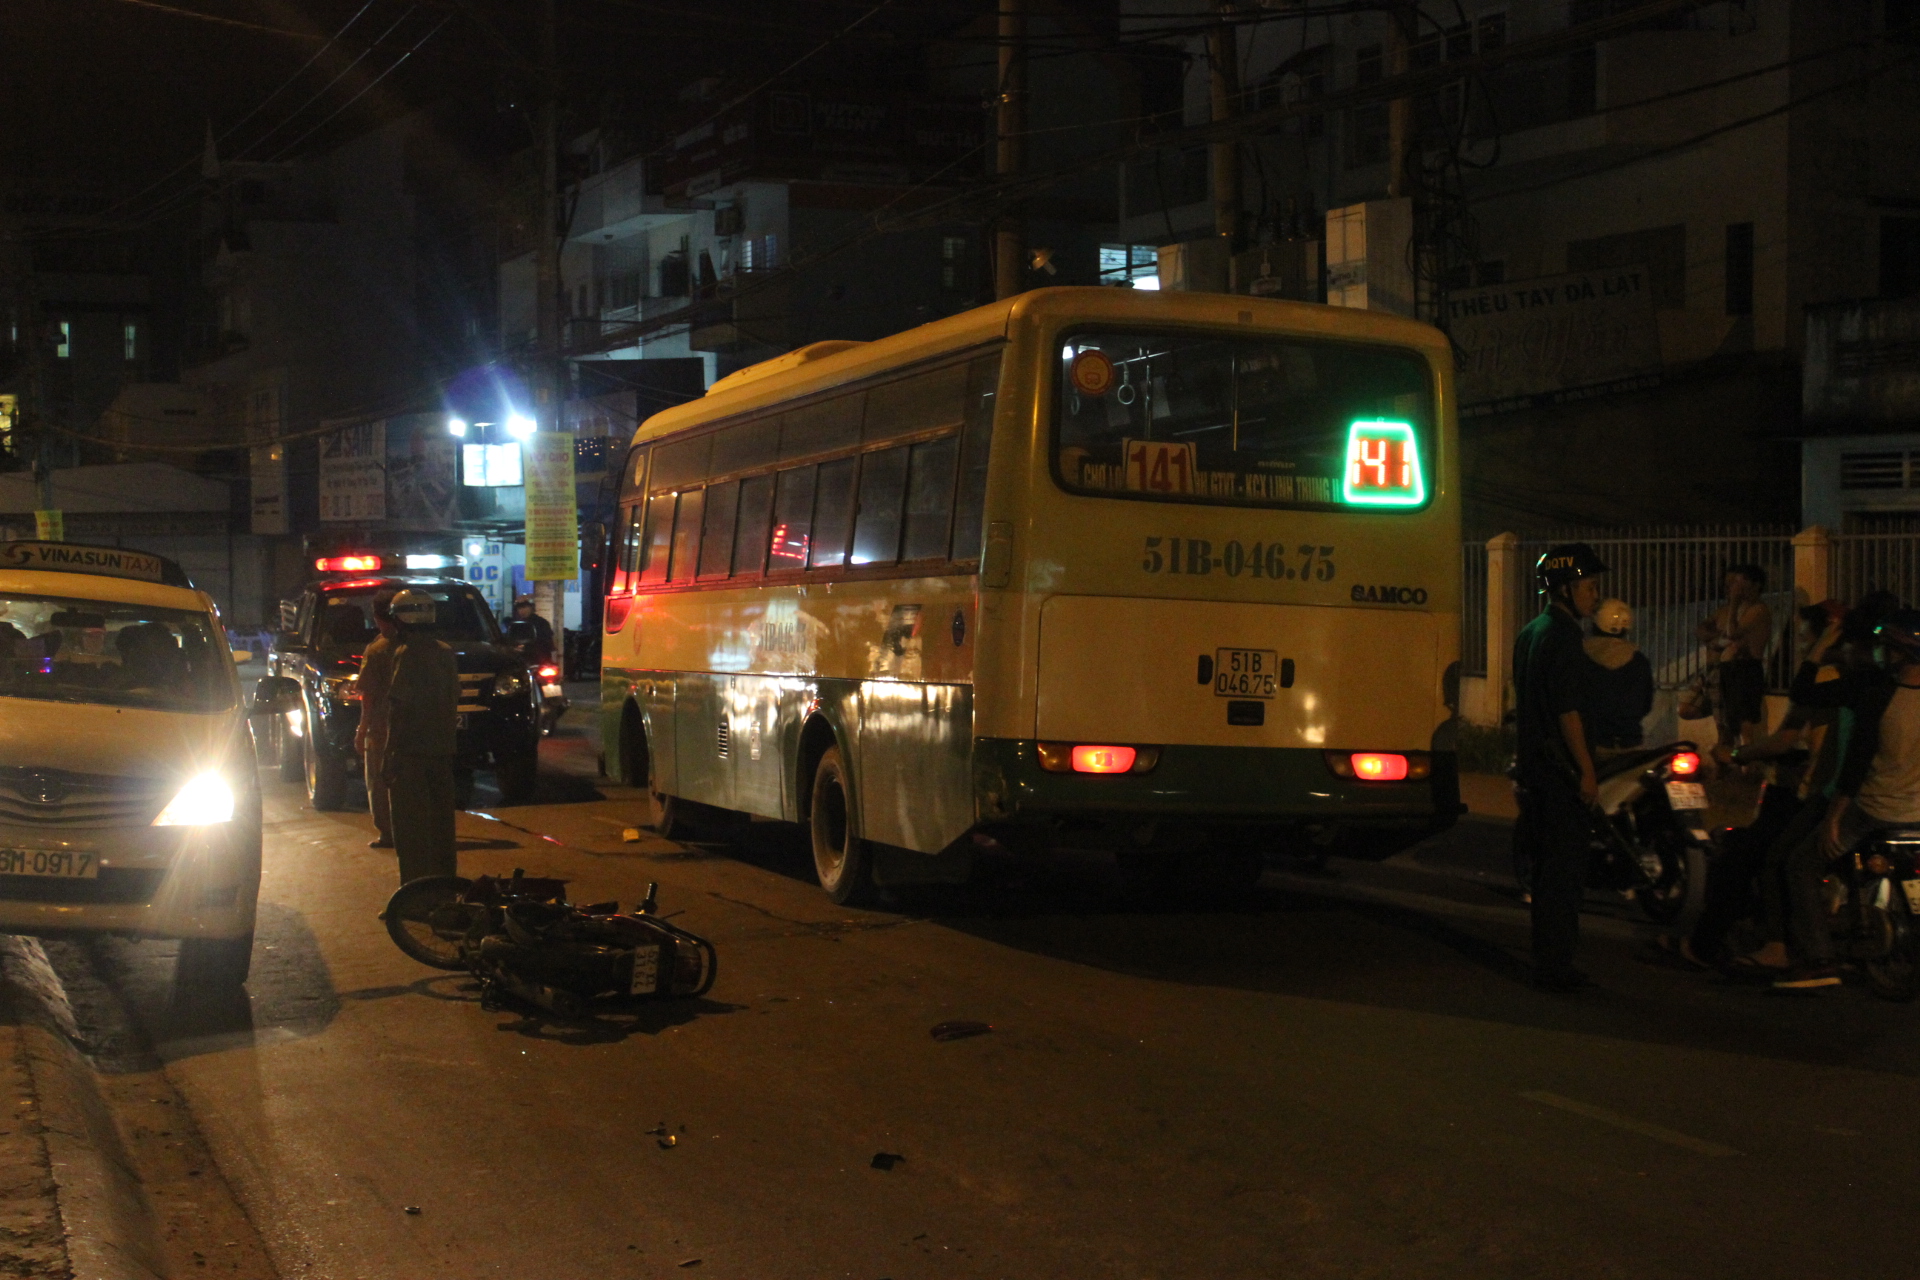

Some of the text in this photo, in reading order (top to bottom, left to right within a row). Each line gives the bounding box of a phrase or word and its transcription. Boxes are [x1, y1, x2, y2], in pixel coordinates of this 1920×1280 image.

[1518, 287, 1557, 309] TAY
[1131, 445, 1188, 493] 141
[1352, 439, 1410, 486] 141
[1142, 536, 1336, 582] 51B-046.75
[1351, 585, 1428, 605] SAMCO
[1230, 651, 1262, 673] 51B
[1217, 673, 1274, 695] 046.75
